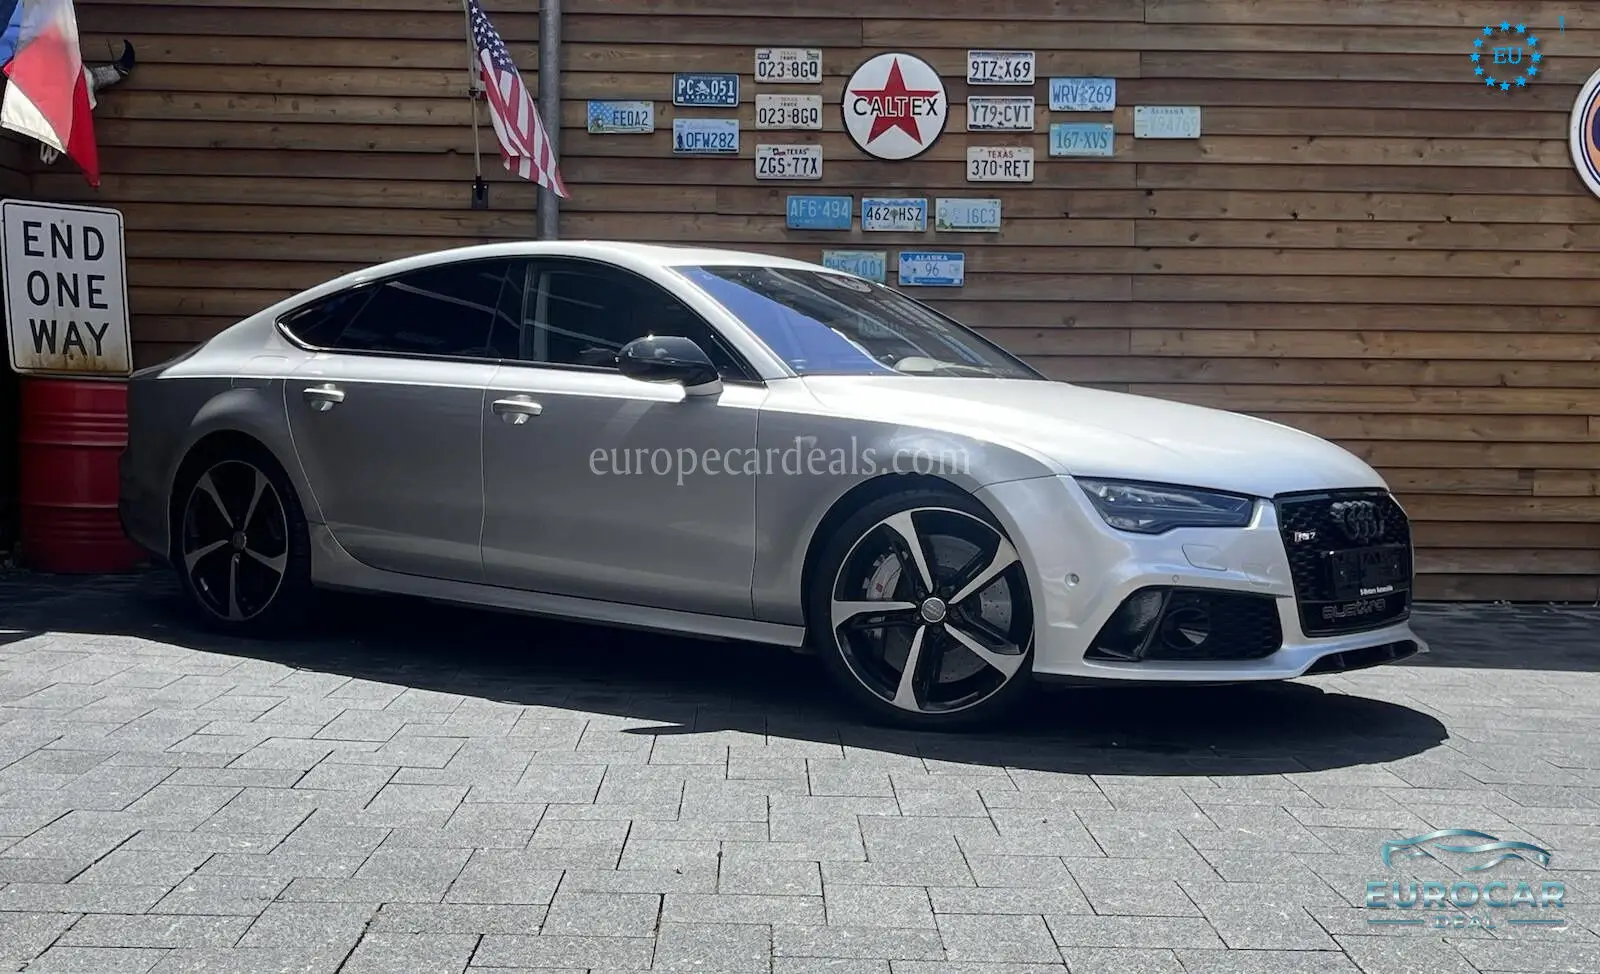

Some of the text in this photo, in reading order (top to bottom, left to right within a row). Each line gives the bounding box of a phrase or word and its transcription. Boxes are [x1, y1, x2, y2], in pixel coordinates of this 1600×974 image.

[678, 80, 735, 96] PC 051
[1052, 85, 1078, 103] WRV
[853, 97, 938, 118] CALTEX
[988, 150, 1014, 158] TEXAS
[866, 207, 889, 221] 462
[23, 220, 104, 261] END
[27, 270, 108, 309] ONE
[29, 318, 109, 356] WAY
